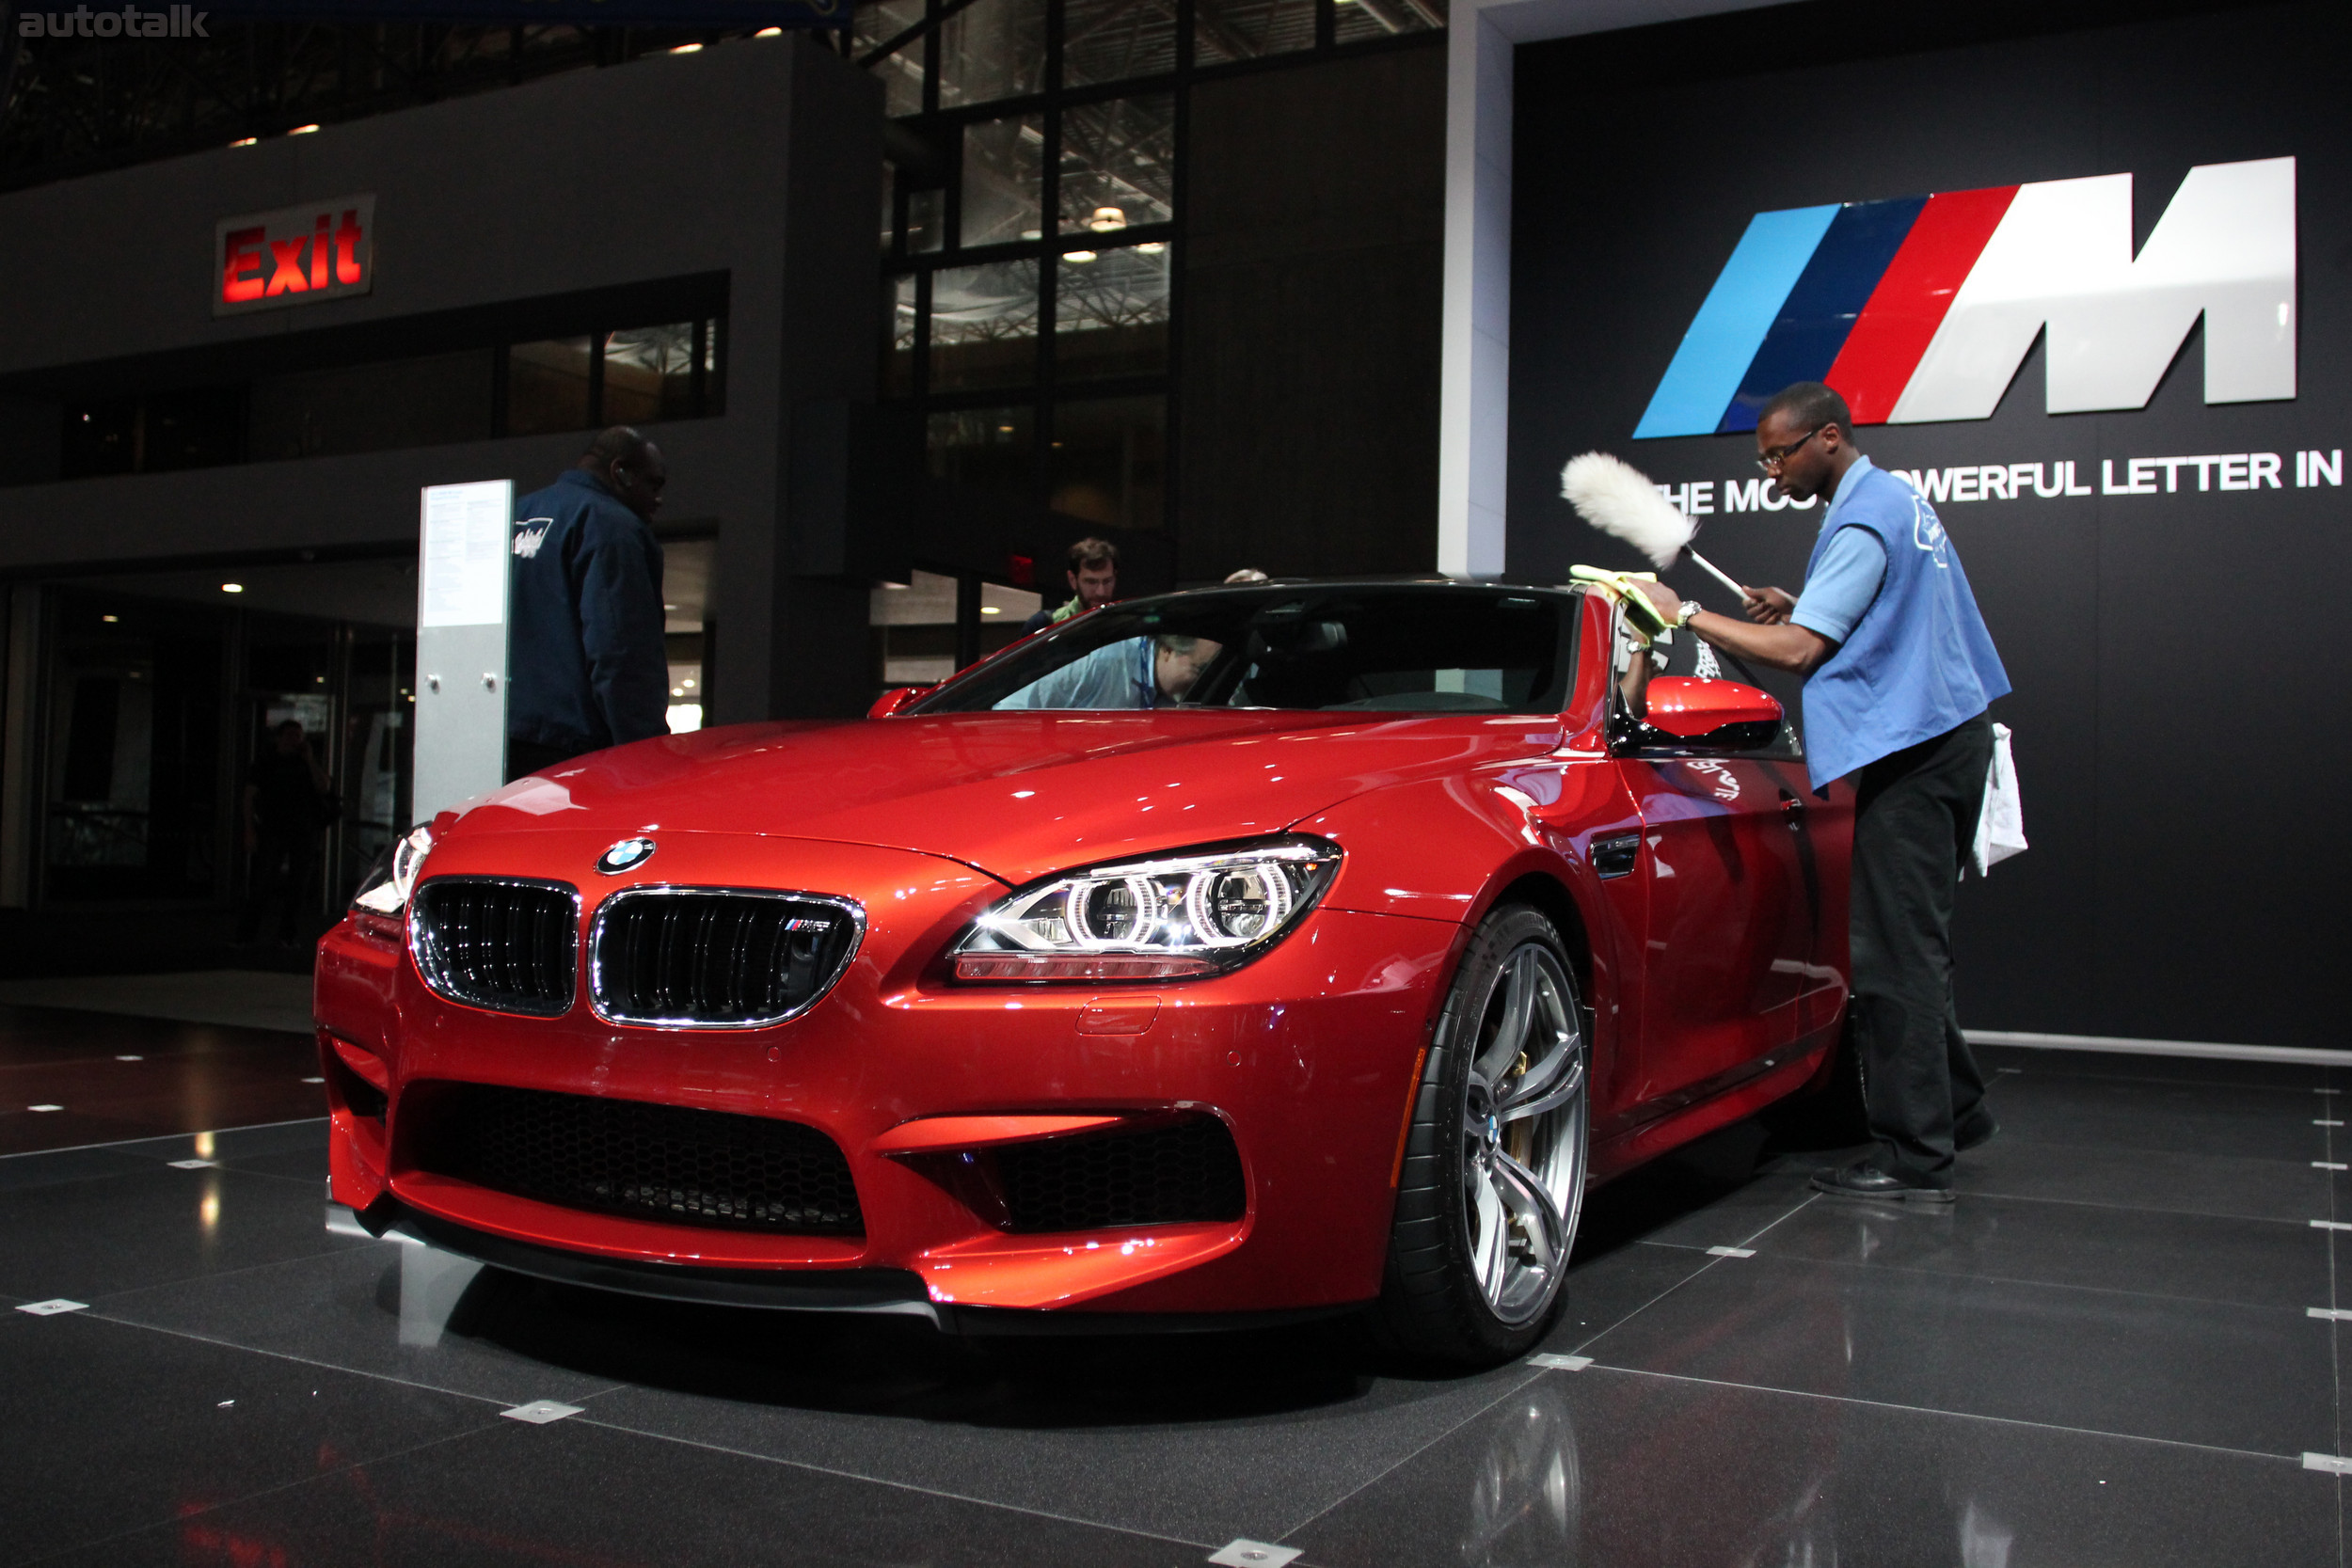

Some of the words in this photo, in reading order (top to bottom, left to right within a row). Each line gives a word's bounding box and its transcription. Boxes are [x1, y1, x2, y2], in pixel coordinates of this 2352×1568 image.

[223, 210, 362, 303] Exit
[1724, 478, 1830, 511] MO
[1888, 461, 2091, 503] WERFUL
[2102, 452, 2282, 495] LETTER
[2296, 449, 2343, 487] IN
